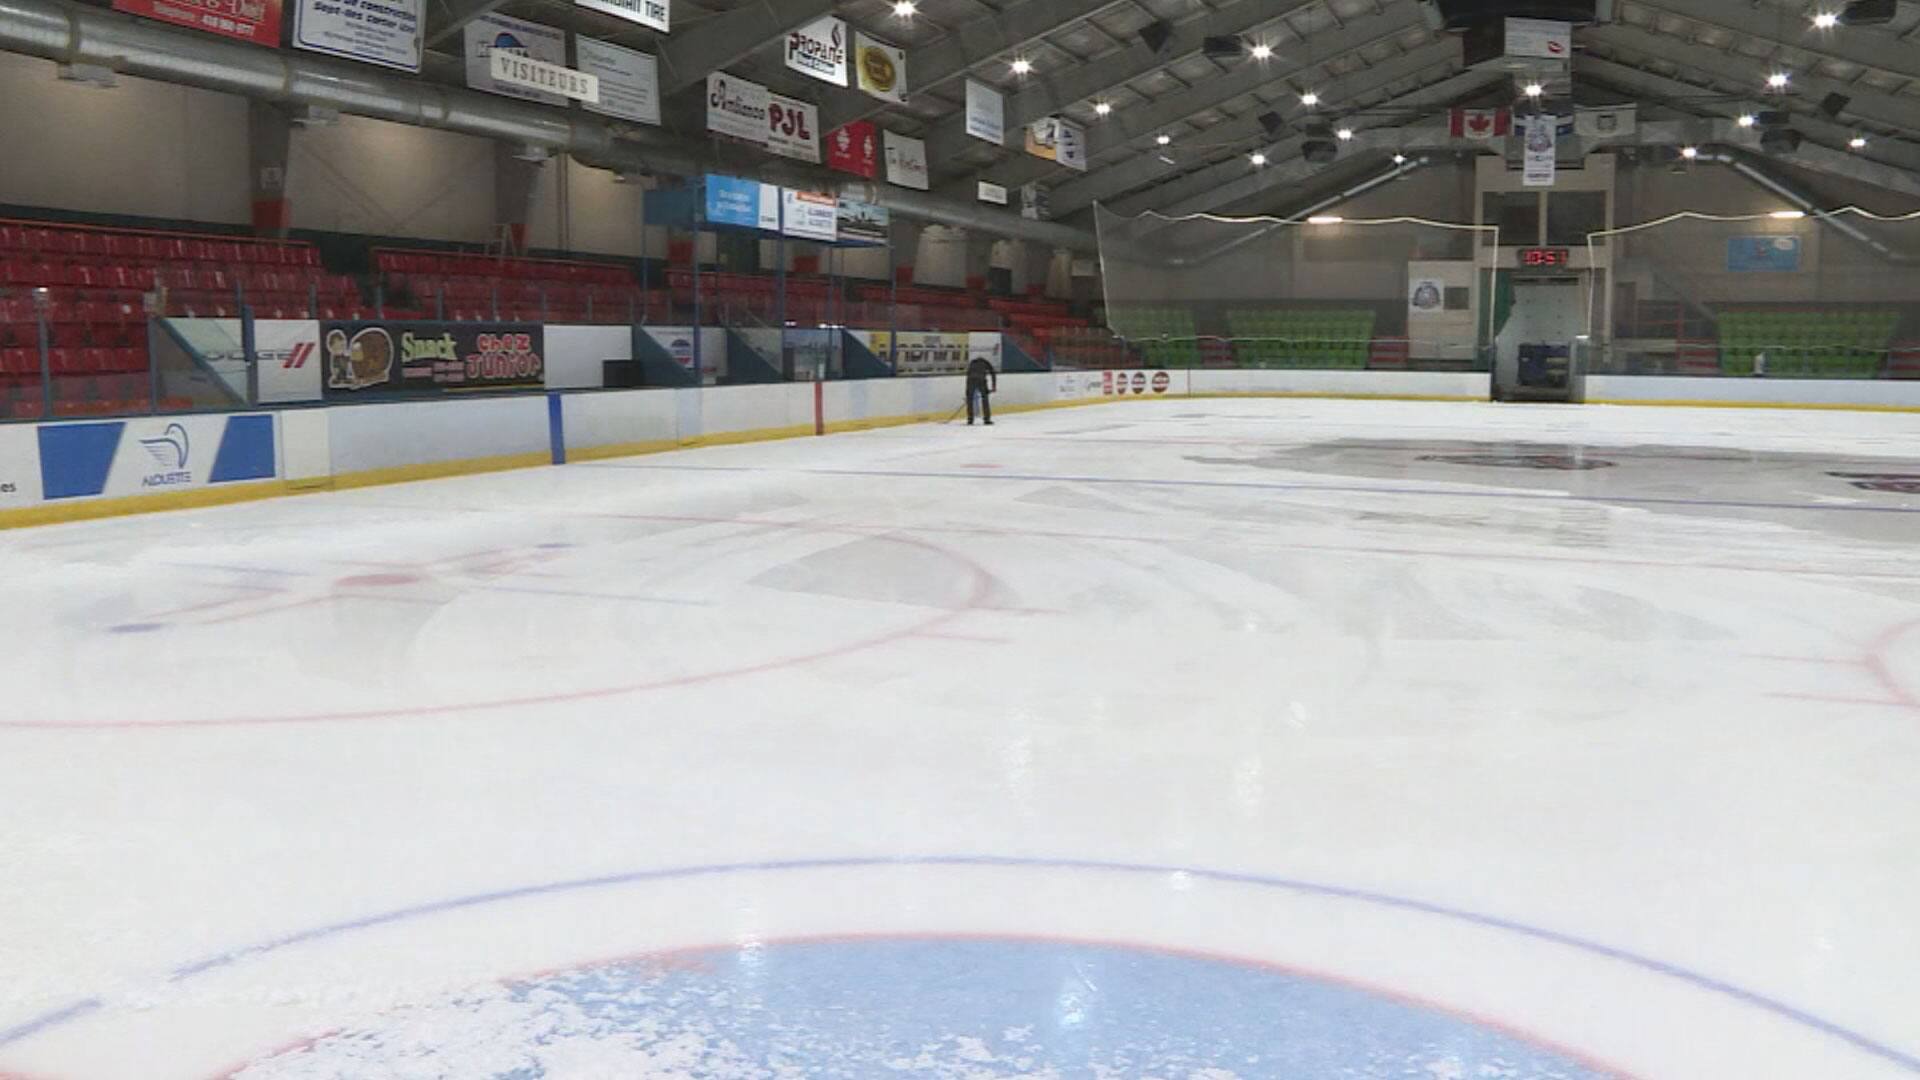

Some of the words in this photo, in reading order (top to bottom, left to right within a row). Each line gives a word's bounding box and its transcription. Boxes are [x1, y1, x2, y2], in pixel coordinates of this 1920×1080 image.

[645, 1, 665, 22] TIRE
[788, 32, 843, 65] PROPANE
[500, 57, 589, 95] VISITEURS
[768, 103, 810, 140] PJL
[402, 331, 459, 363] Snack
